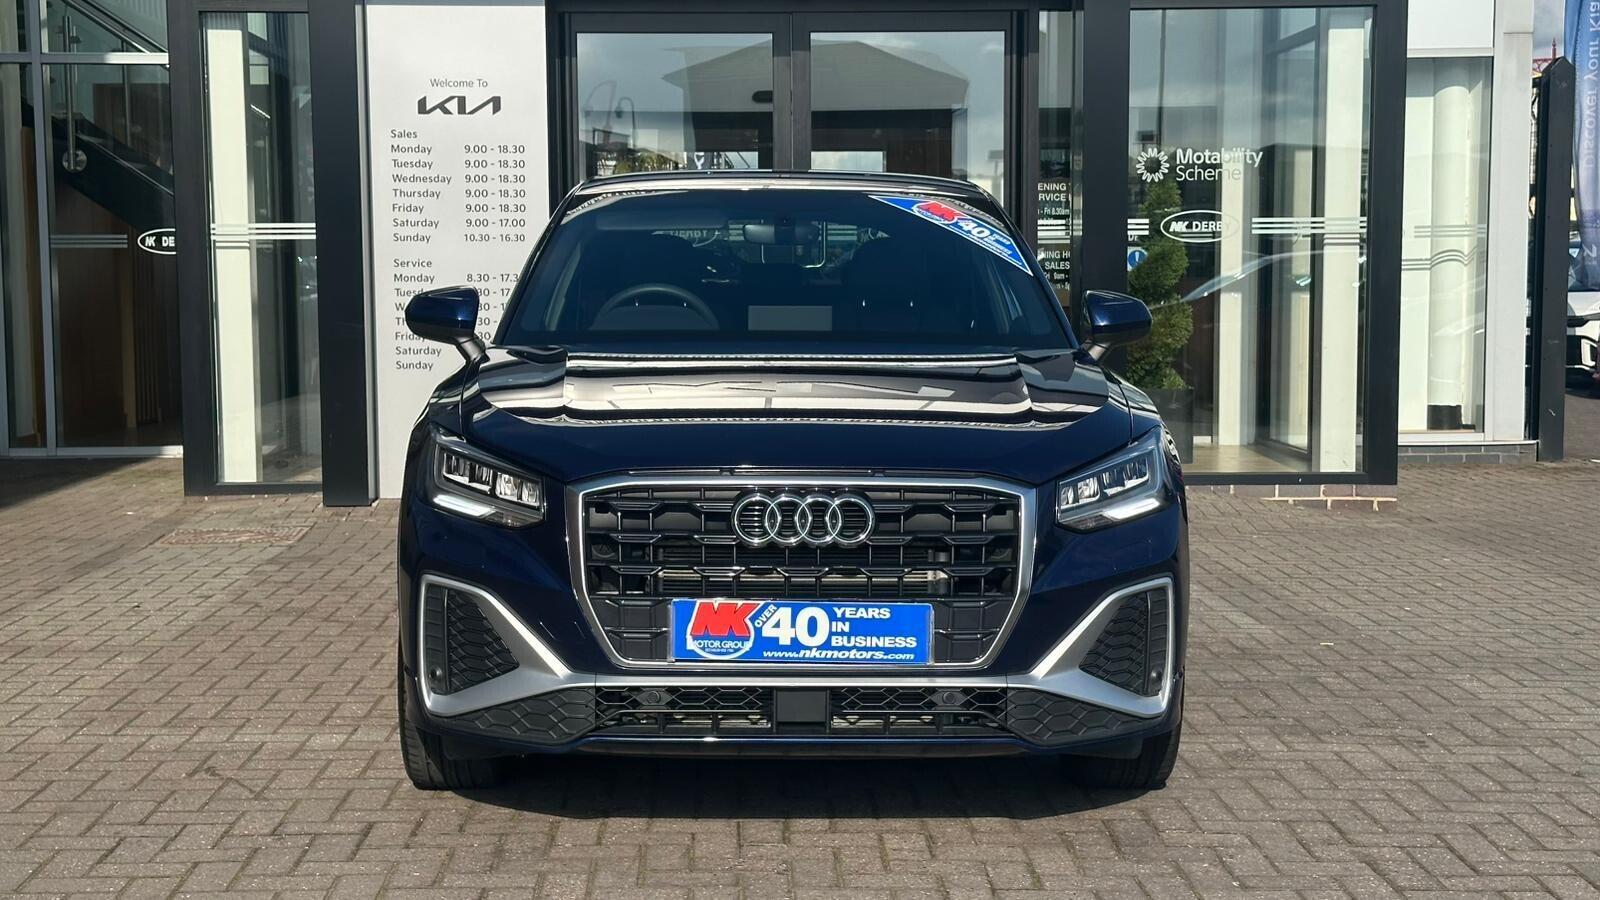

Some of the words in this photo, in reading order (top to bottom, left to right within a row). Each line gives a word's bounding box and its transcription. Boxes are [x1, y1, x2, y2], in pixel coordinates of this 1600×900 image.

[430, 78, 474, 88] Welcome
[477, 78, 489, 88] To
[417, 95, 502, 115] KIA
[390, 129, 418, 139] Sales
[390, 144, 432, 155] Monday
[464, 145, 487, 154] 9.00
[498, 145, 525, 154] 18.30
[1176, 147, 1263, 168] Motability
[392, 159, 433, 170] Tuesday
[464, 159, 488, 168] 9.00
[498, 159, 525, 168] 18.30
[1176, 165, 1241, 181] Scheme
[392, 174, 452, 185] Wednesday
[464, 174, 488, 183] 9.00
[498, 174, 525, 183] 18.30
[1037, 182, 1067, 191] ENING
[392, 188, 441, 200] Thursday
[465, 189, 488, 198] 9.00
[498, 189, 525, 198] 18.30
[1038, 193, 1067, 201] RVICE
[392, 203, 424, 214] Friday
[465, 204, 488, 213] 9.00
[499, 203, 526, 213] 18.30
[393, 218, 439, 229] Saturday
[465, 218, 488, 227] 9.00
[499, 218, 525, 227] 17.00
[957, 220, 991, 238] 40
[393, 233, 431, 244] Sunday
[464, 233, 489, 243] 10.30
[500, 233, 525, 243] 16.30
[394, 258, 433, 269] Service
[1044, 261, 1070, 270] SALES
[394, 273, 435, 284] Monday
[466, 273, 490, 283] 8.30
[500, 273, 519, 283] 17.3
[396, 346, 442, 358] Saturday
[396, 360, 433, 372] Sunday
[754, 604, 778, 629] OVER
[832, 607, 891, 619] YEARS
[690, 602, 760, 637] NK
[761, 606, 830, 647] 40
[831, 621, 849, 633] IN
[831, 636, 917, 648] BUSINESS
[762, 648, 915, 660] www.nkmotors.com
